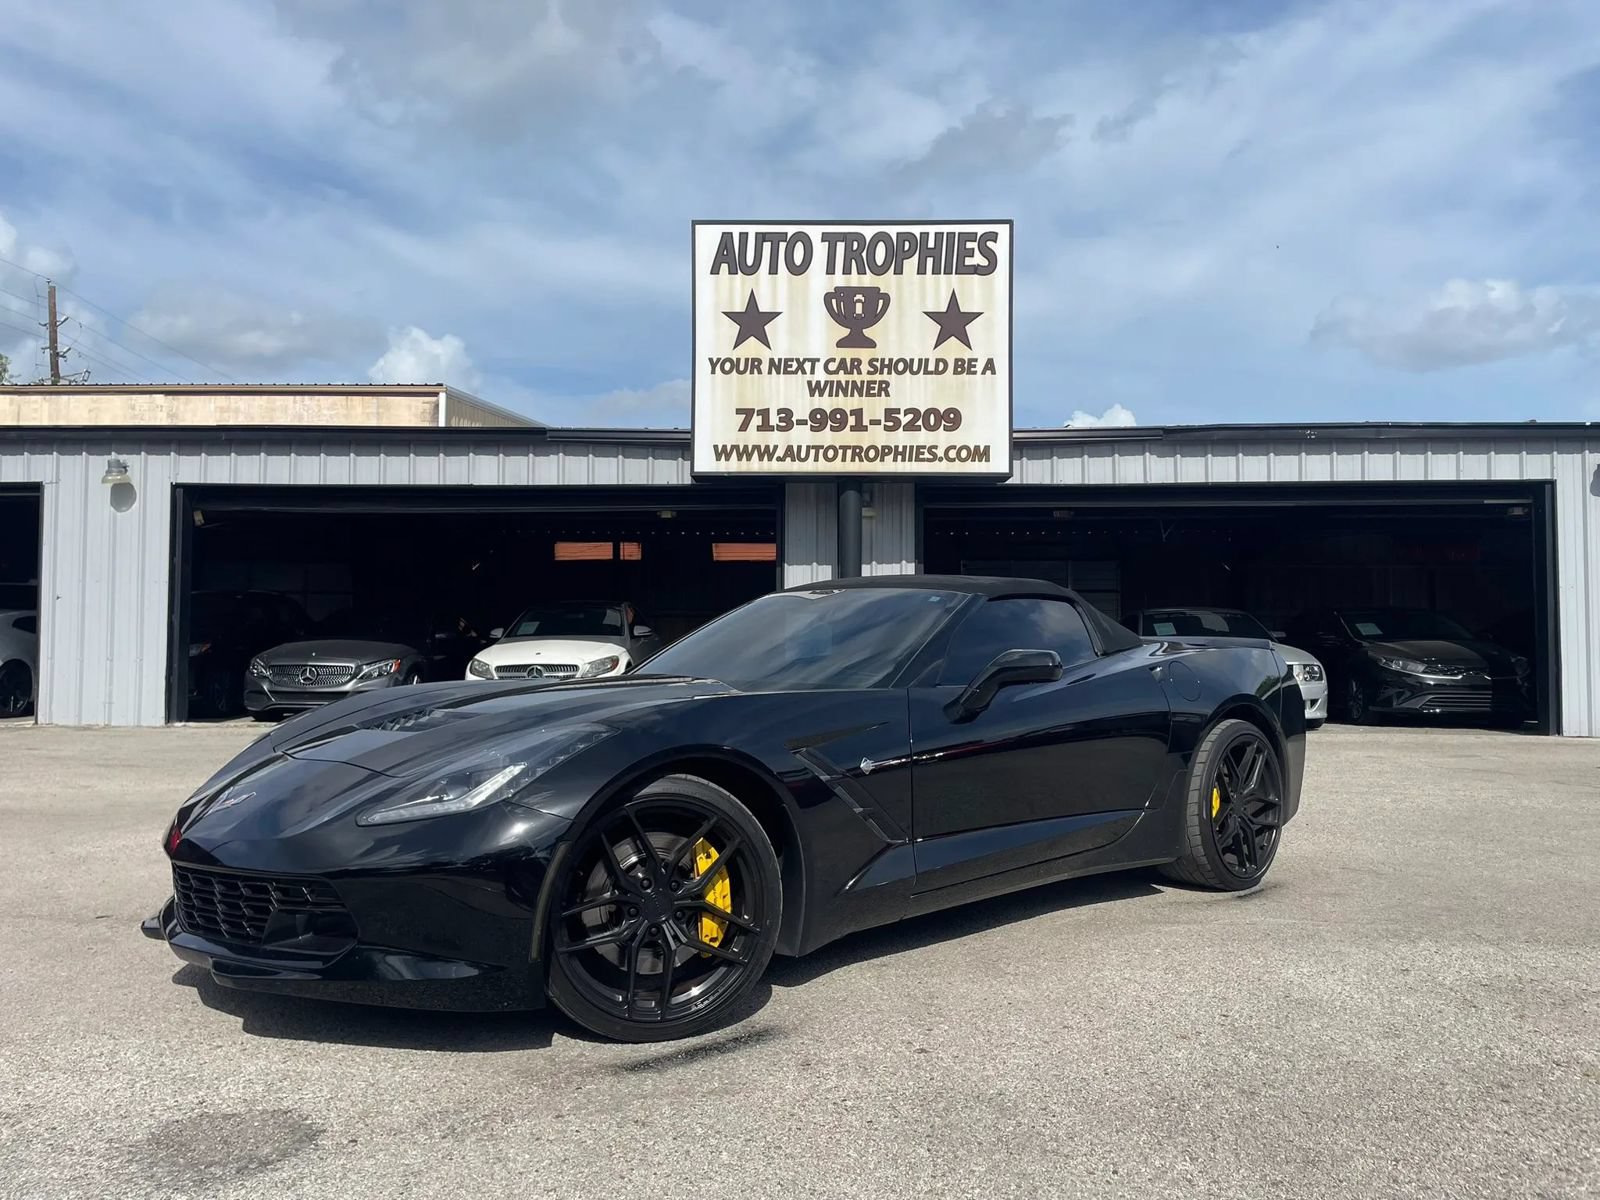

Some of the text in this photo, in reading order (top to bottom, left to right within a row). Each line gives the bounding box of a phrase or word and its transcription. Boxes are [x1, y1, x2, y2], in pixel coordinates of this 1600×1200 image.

[710, 231, 998, 276] AUTO TROPHIES
[708, 357, 996, 375] YOUR NEXT CAR SHOULD BE A
[807, 380, 890, 397] WINNER
[735, 407, 962, 432] 713-991-5209
[712, 444, 991, 463] WWW.AUTOTROPHIES.COM
